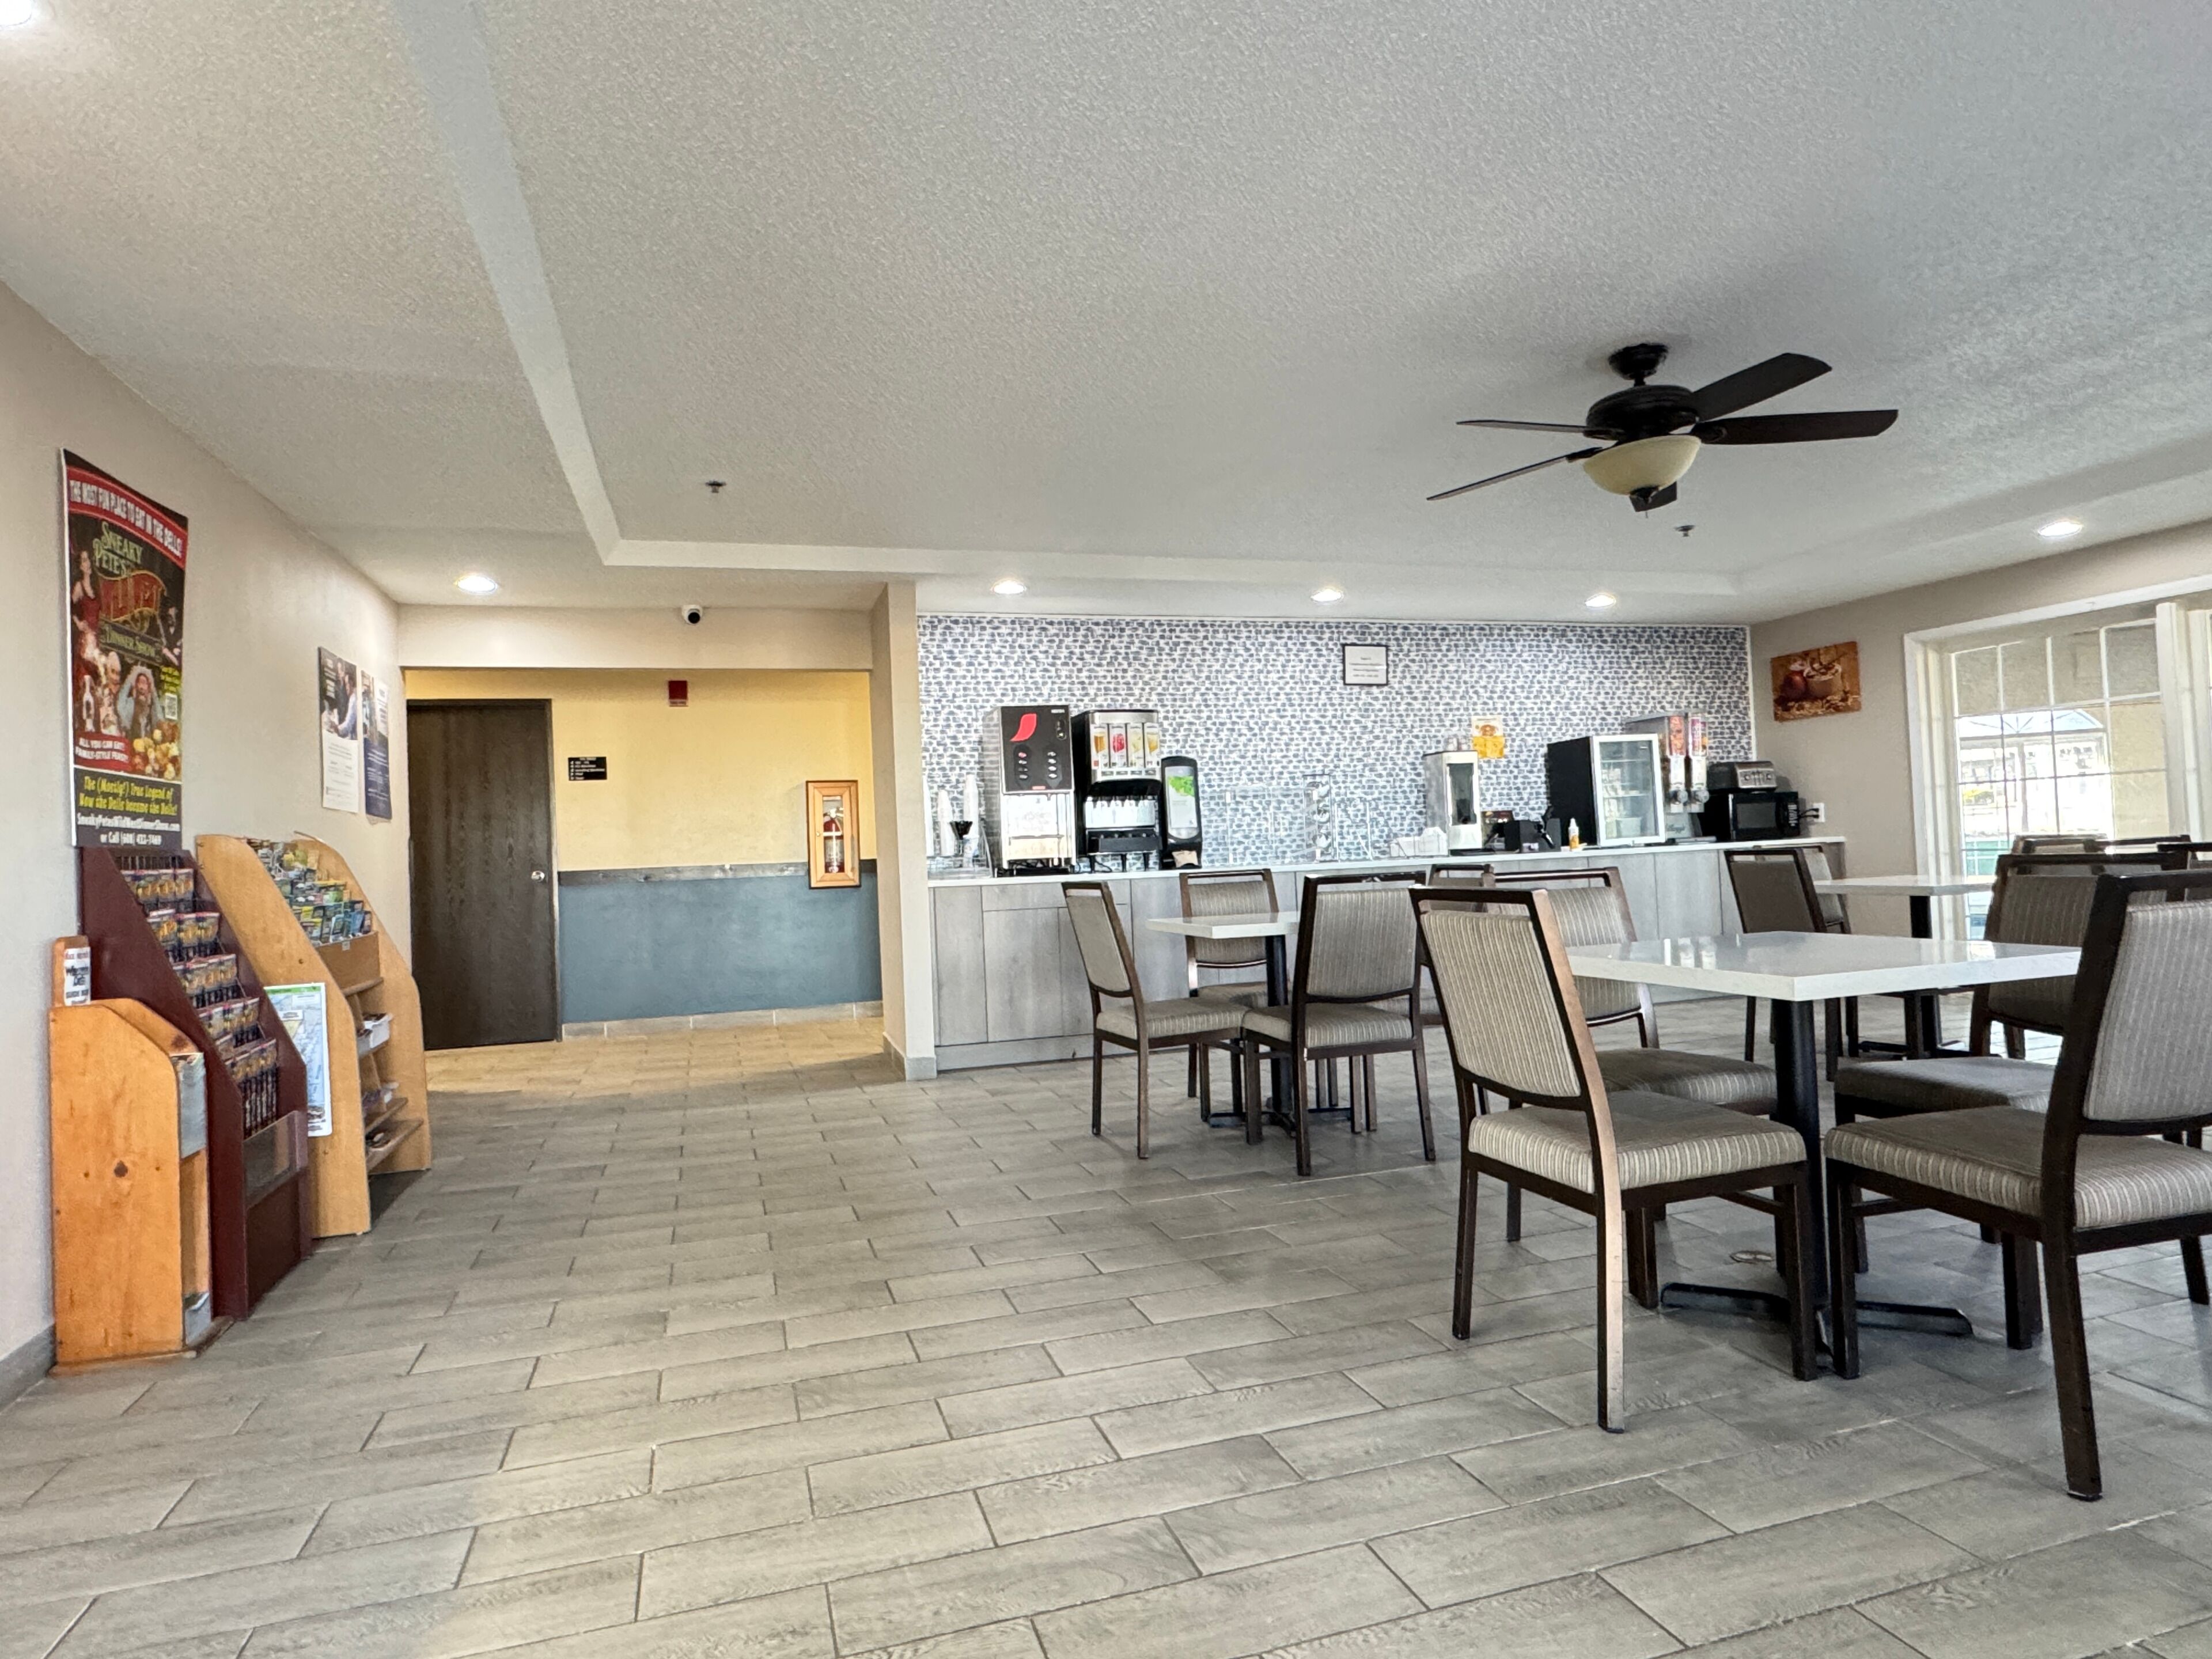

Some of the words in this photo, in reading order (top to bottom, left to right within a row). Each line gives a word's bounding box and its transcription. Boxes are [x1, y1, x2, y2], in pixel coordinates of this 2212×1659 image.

[101, 521, 143, 564] SNEAKY
[84, 776, 95, 790] The
[108, 831, 119, 844] Call
